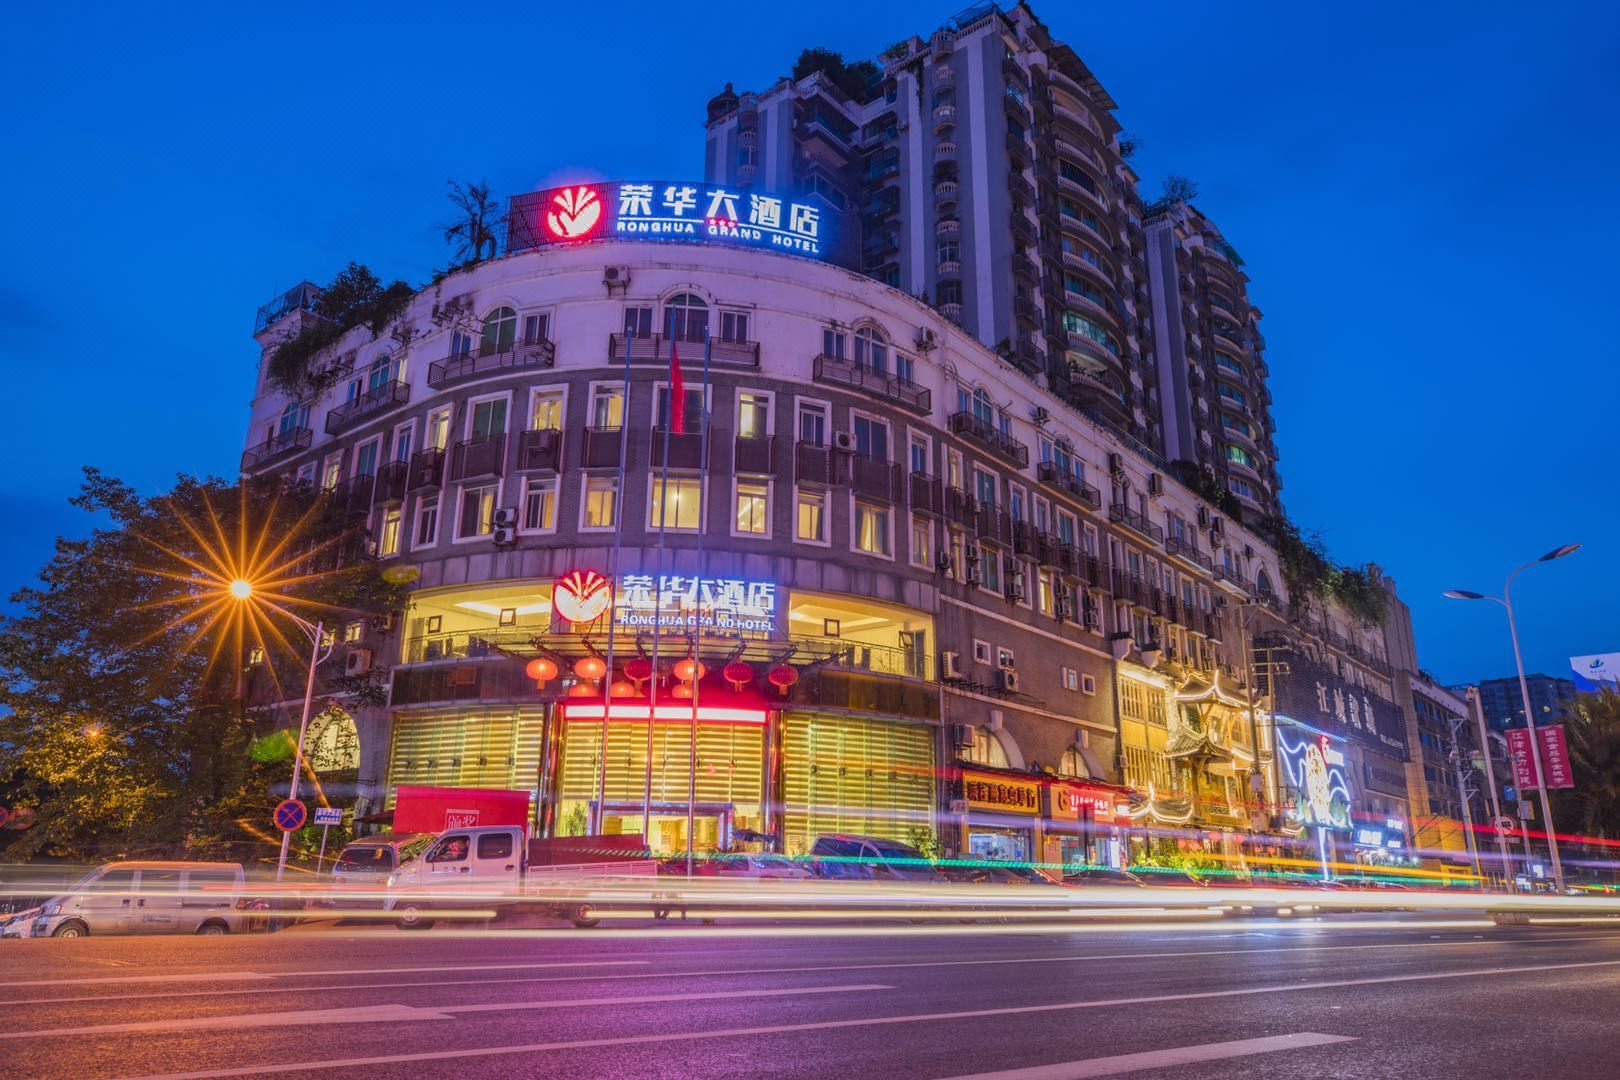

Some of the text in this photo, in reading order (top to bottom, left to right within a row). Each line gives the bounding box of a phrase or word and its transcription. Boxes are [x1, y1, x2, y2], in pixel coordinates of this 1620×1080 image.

[618, 184, 819, 237] 荣华大酒店
[616, 222, 819, 253] RONGHUA GRAND HOTEL
[622, 574, 775, 611] 荣华大酒店
[620, 615, 683, 626] RONGHUA
[737, 620, 775, 631] HOTEL
